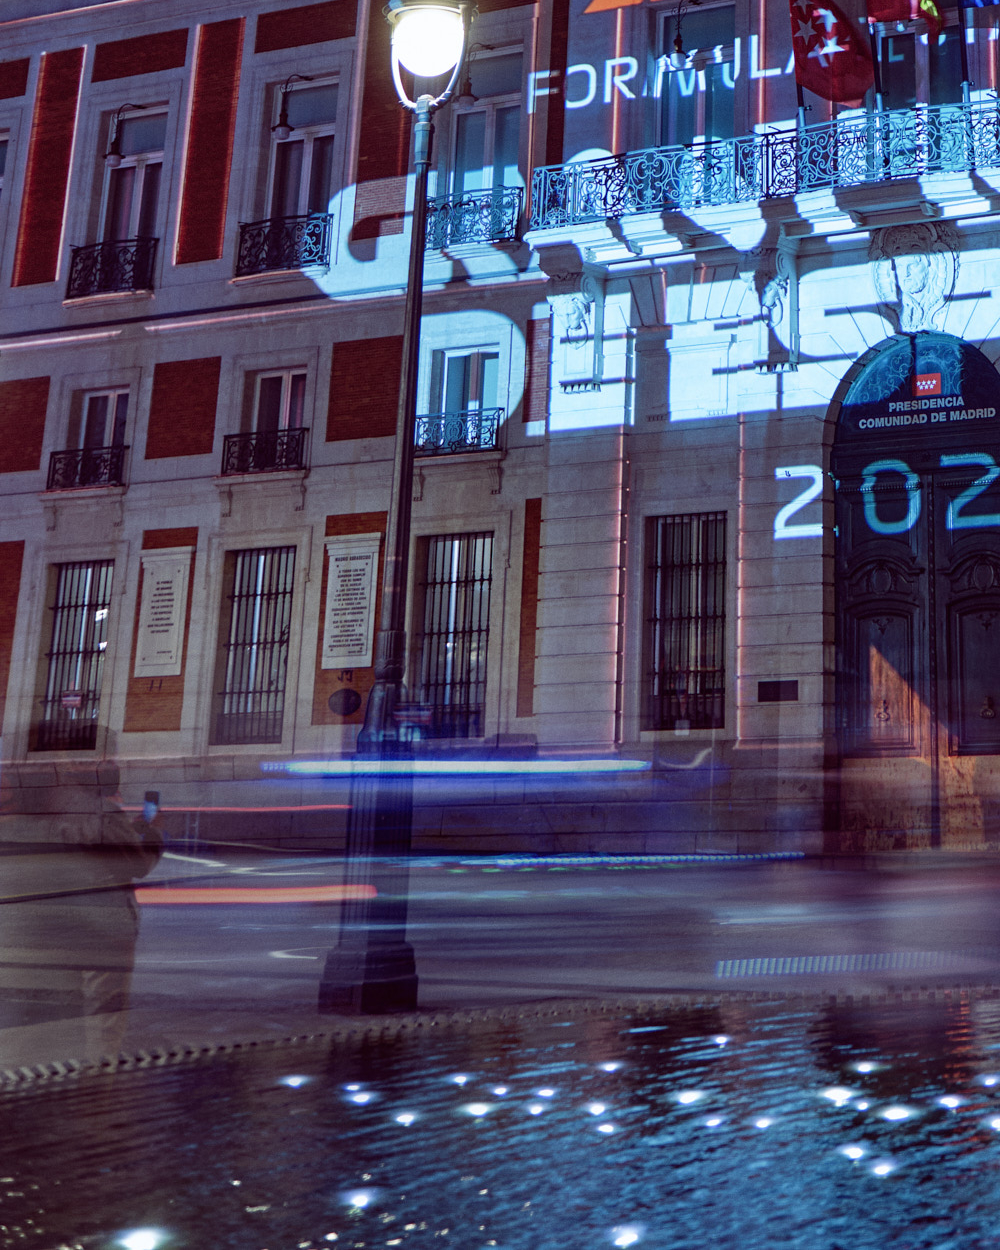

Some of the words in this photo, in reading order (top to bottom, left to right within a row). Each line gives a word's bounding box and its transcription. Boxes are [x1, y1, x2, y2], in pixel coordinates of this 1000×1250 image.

[888, 396, 965, 413] PRESIDENCIA
[858, 413, 928, 430] COMUNIDAD
[930, 411, 947, 423] DE
[949, 407, 996, 421] MADRID
